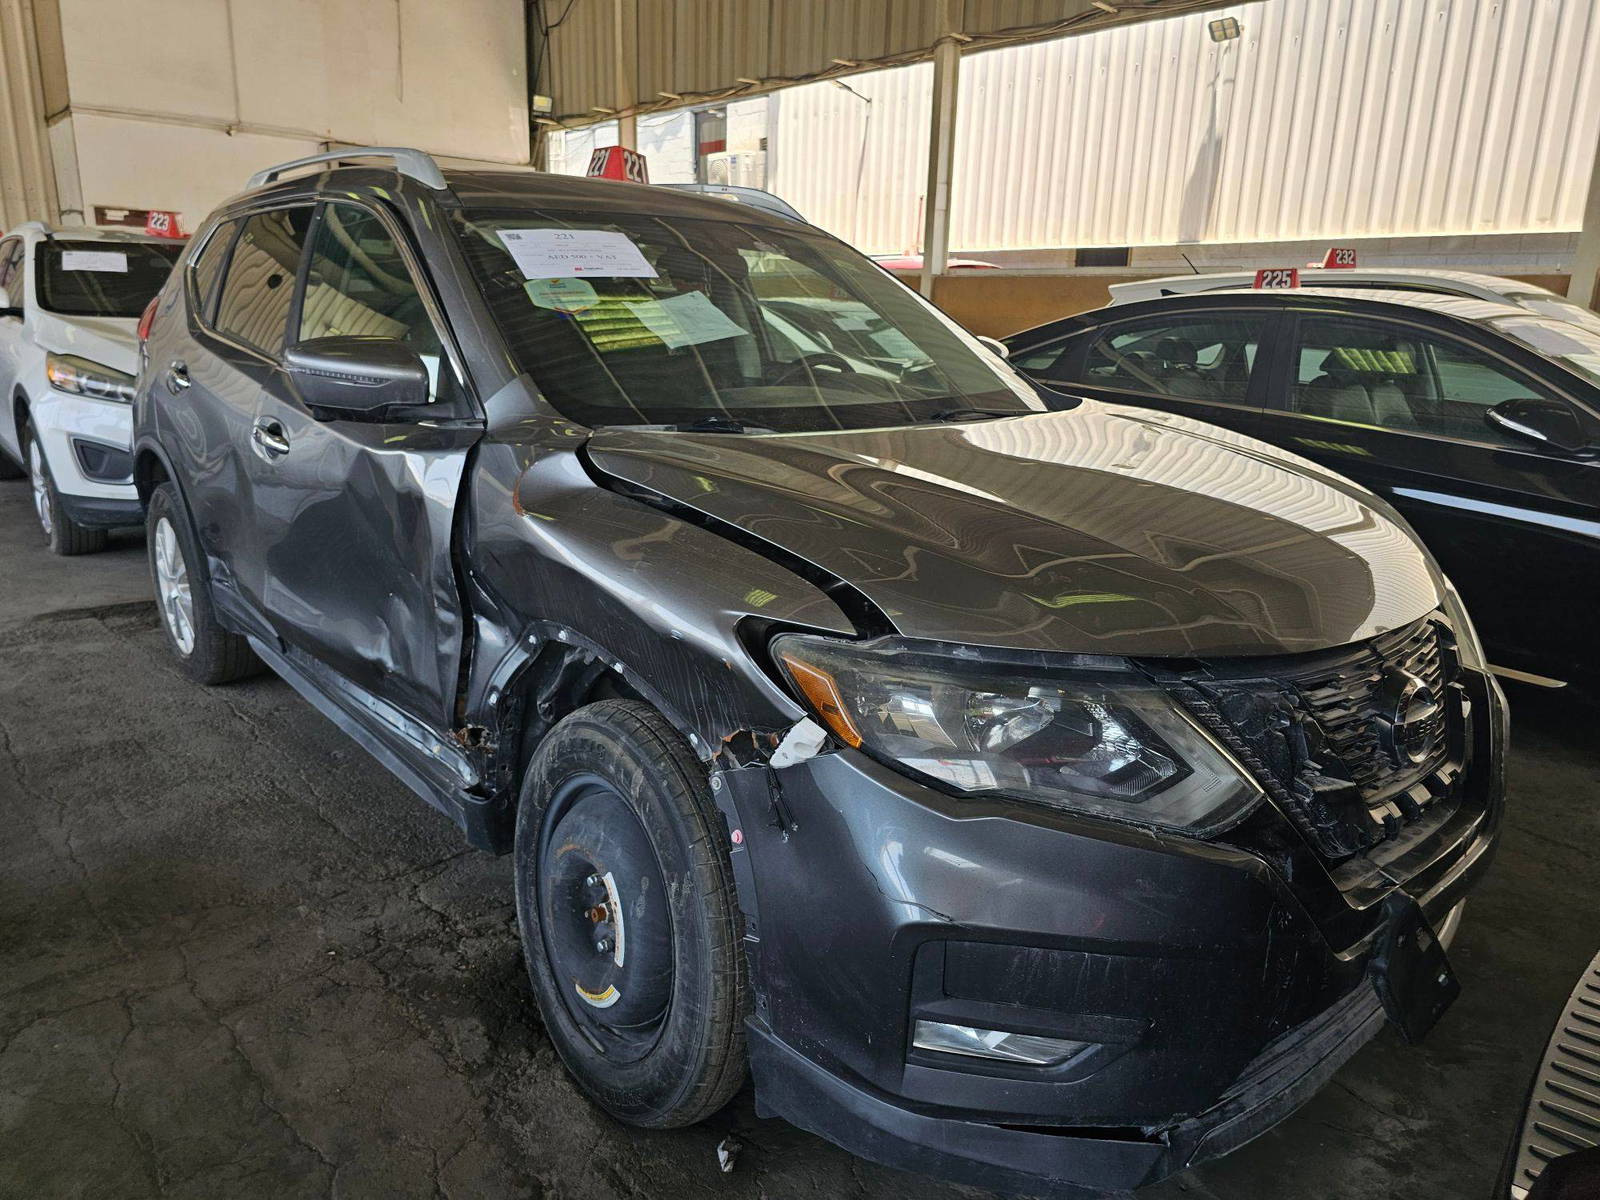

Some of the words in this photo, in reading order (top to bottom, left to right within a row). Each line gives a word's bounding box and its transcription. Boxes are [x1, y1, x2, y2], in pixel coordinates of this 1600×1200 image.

[587, 149, 610, 177] 221
[623, 150, 648, 184] 221
[150, 211, 170, 231] 223
[1335, 249, 1355, 265] 232
[1261, 270, 1292, 289] 225
